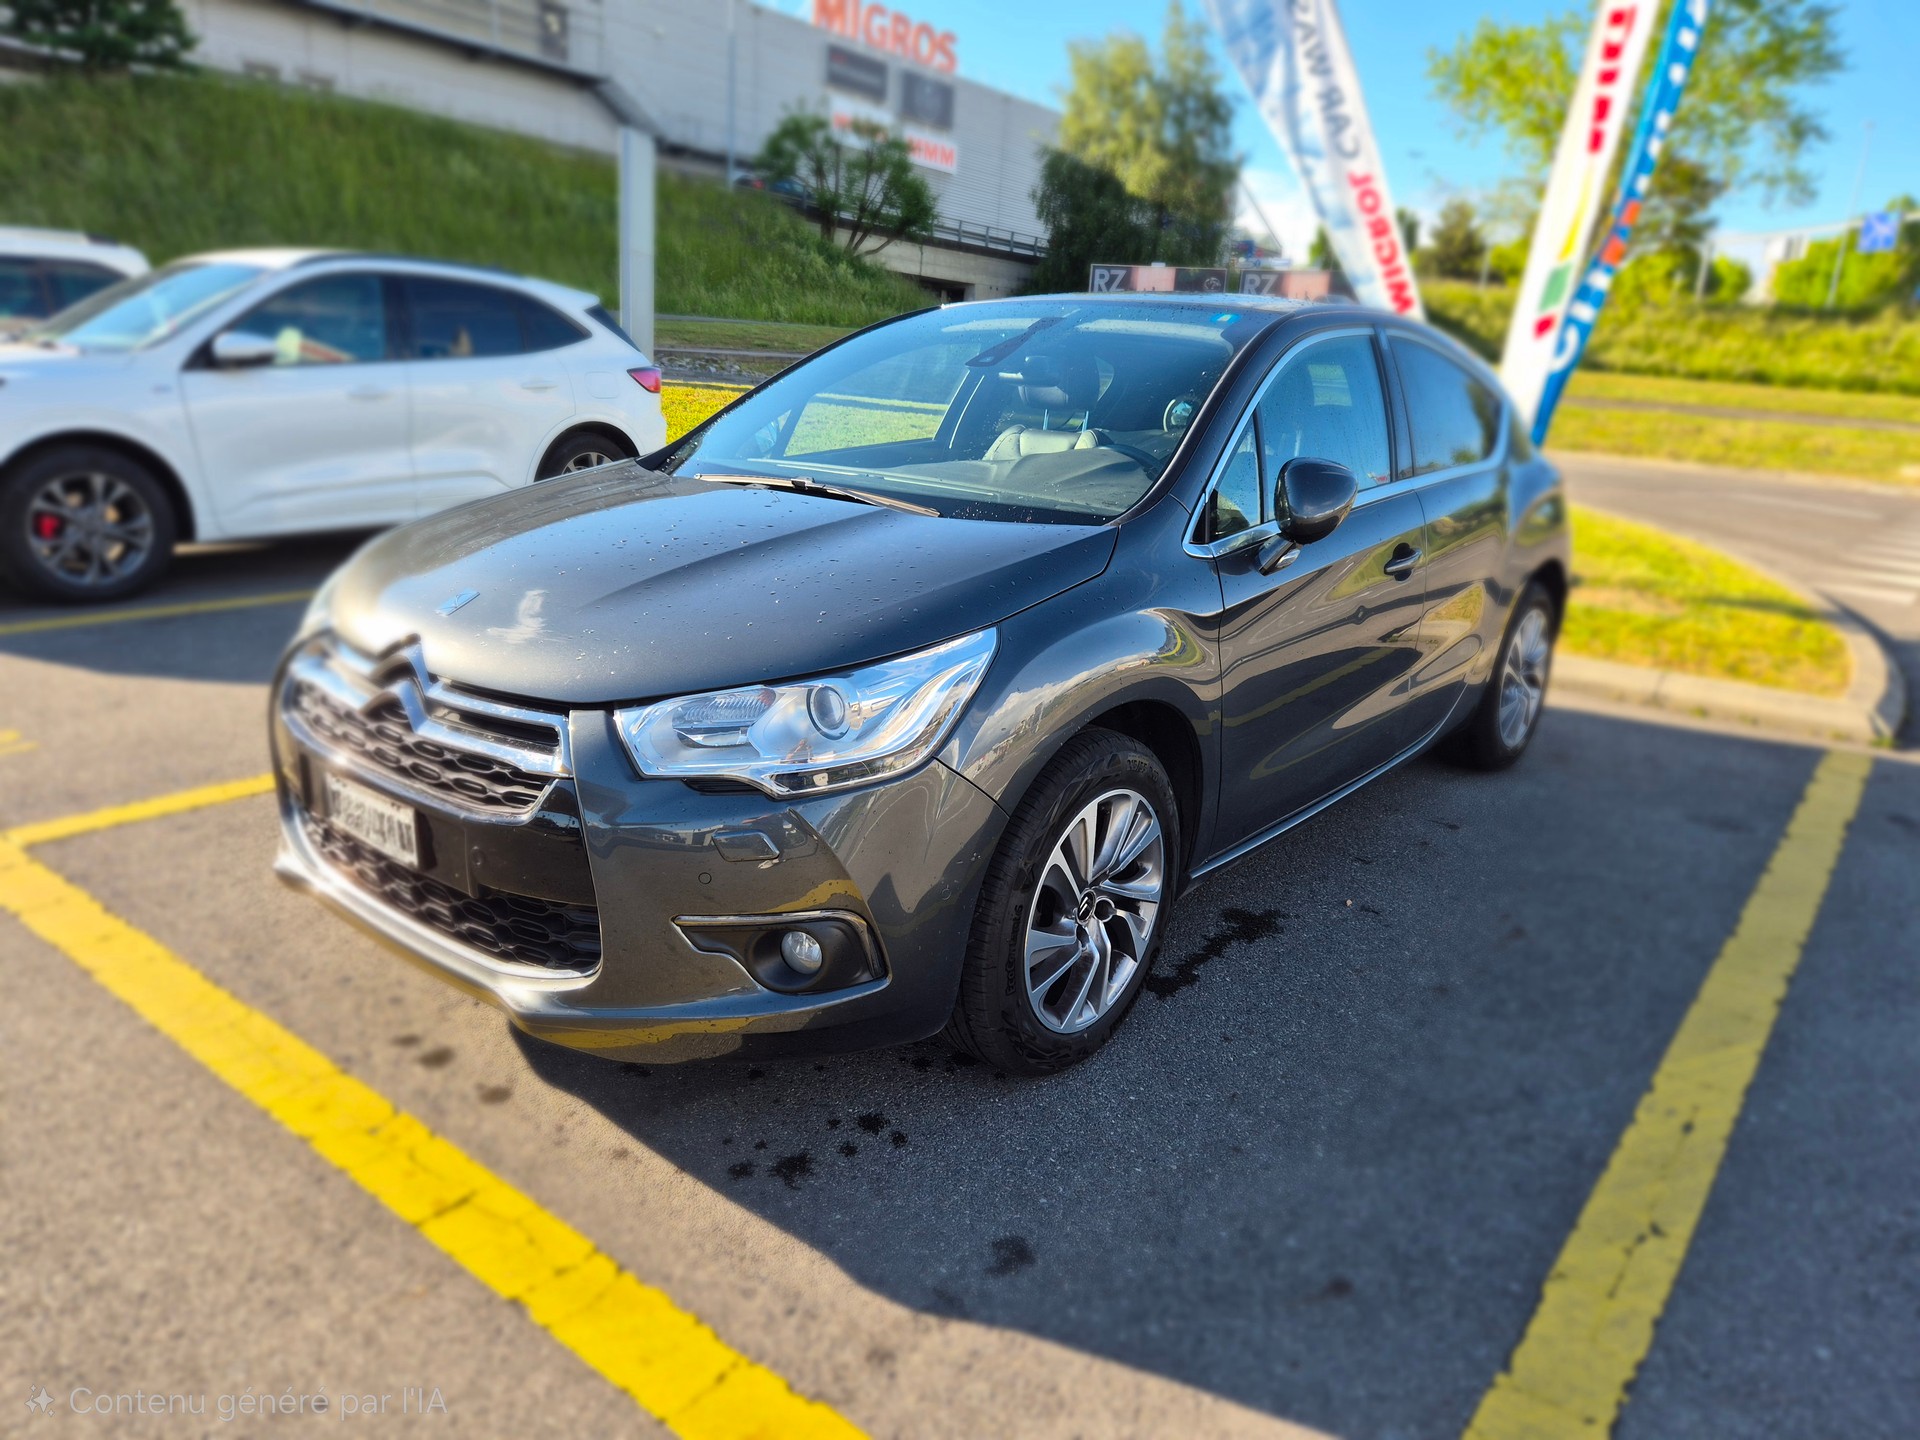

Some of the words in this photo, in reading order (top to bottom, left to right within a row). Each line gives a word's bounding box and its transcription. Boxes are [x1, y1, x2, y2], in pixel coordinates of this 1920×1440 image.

[813, 0, 957, 73] MIGROS
[1093, 268, 1128, 292] RZ
[1243, 273, 1279, 297] RZ
